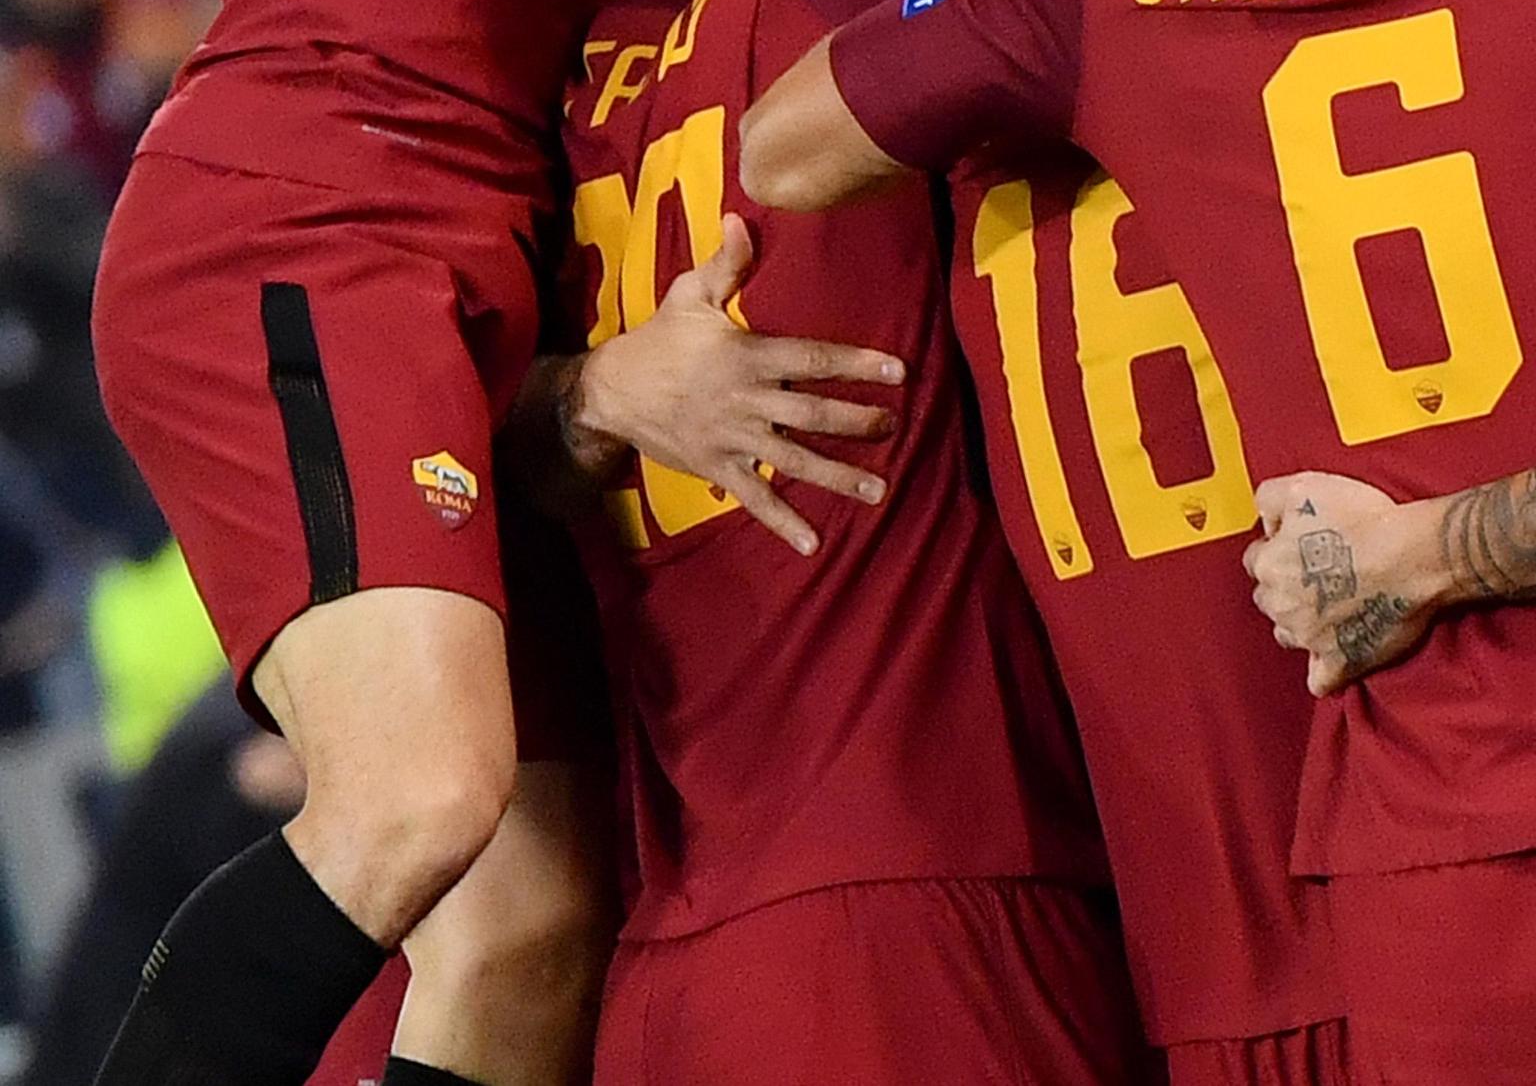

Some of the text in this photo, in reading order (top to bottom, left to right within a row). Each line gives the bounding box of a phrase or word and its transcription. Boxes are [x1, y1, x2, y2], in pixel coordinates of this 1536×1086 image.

[972, 170, 1260, 582] 16
[1262, 7, 1524, 447] 6
[425, 488, 472, 514] ROMA
